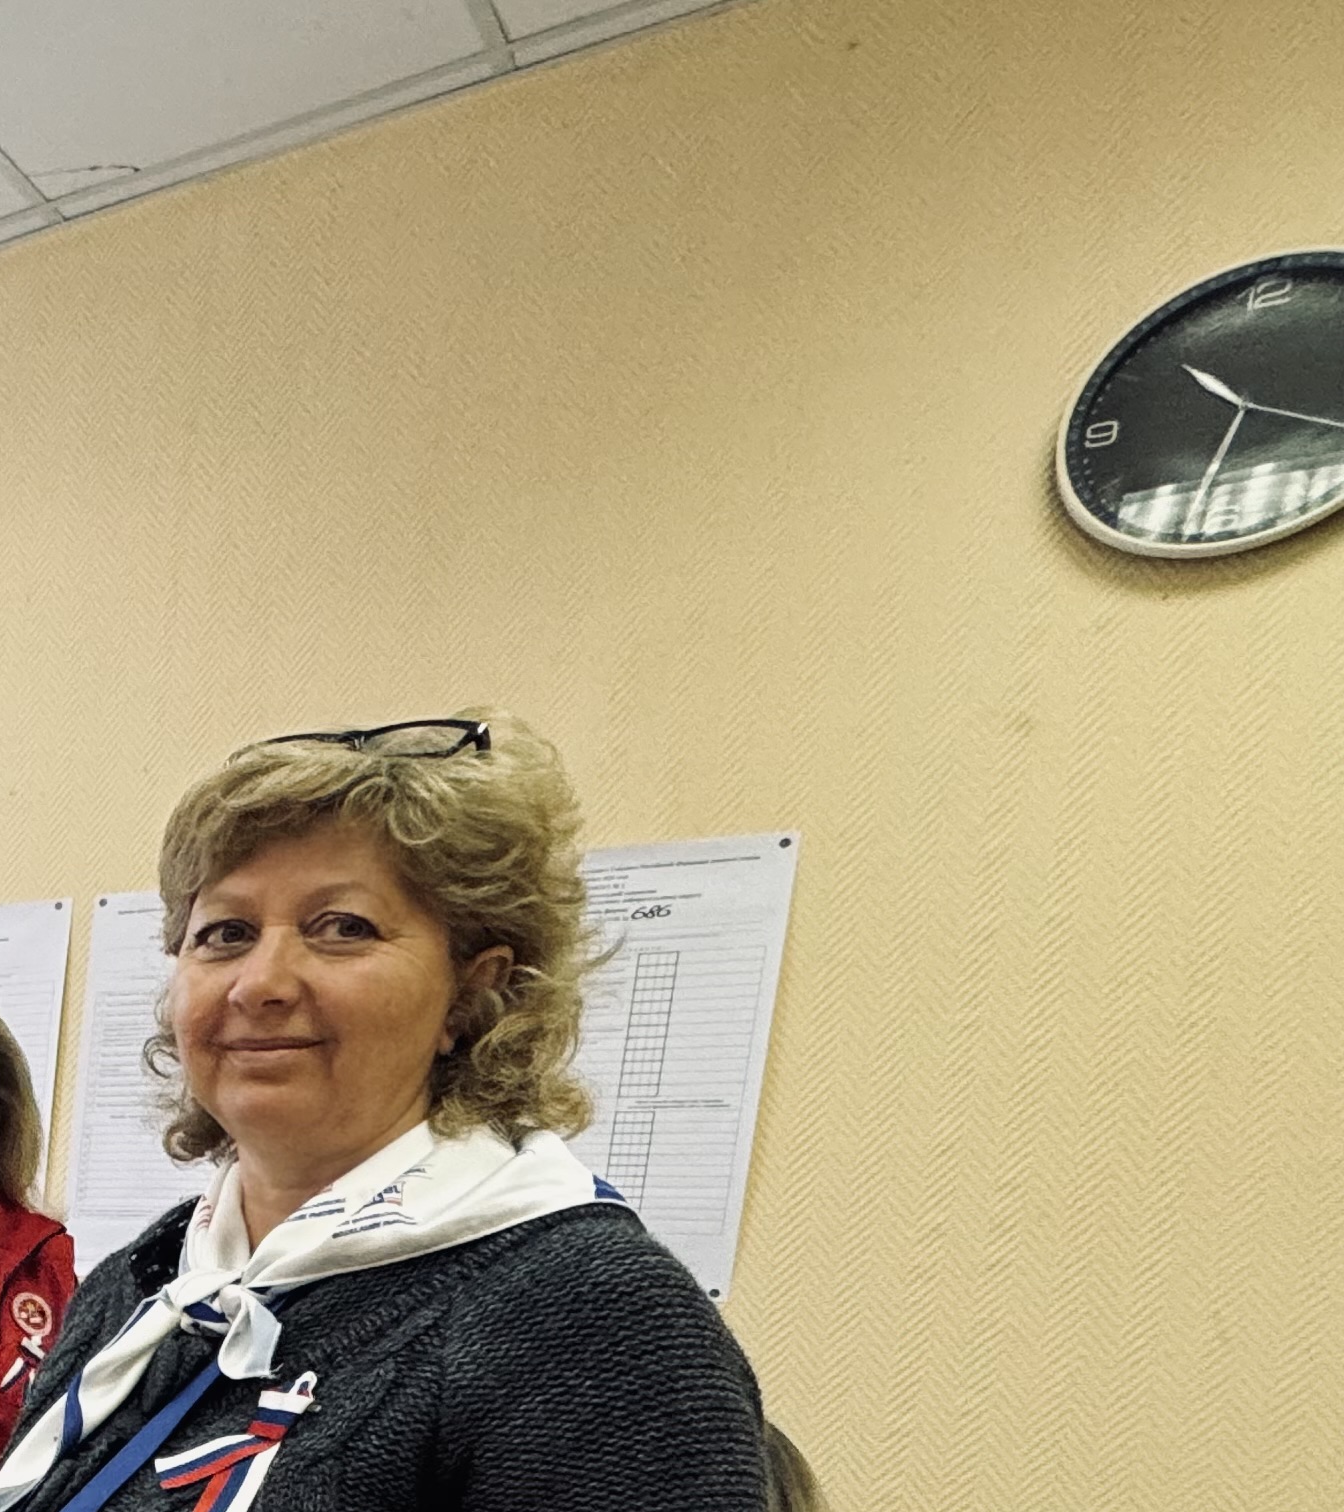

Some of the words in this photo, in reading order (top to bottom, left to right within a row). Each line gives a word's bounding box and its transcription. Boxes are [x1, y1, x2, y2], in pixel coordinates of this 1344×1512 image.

[1237, 279, 1292, 311] 12
[1085, 420, 1118, 448] 9
[631, 904, 672, 920] 686
